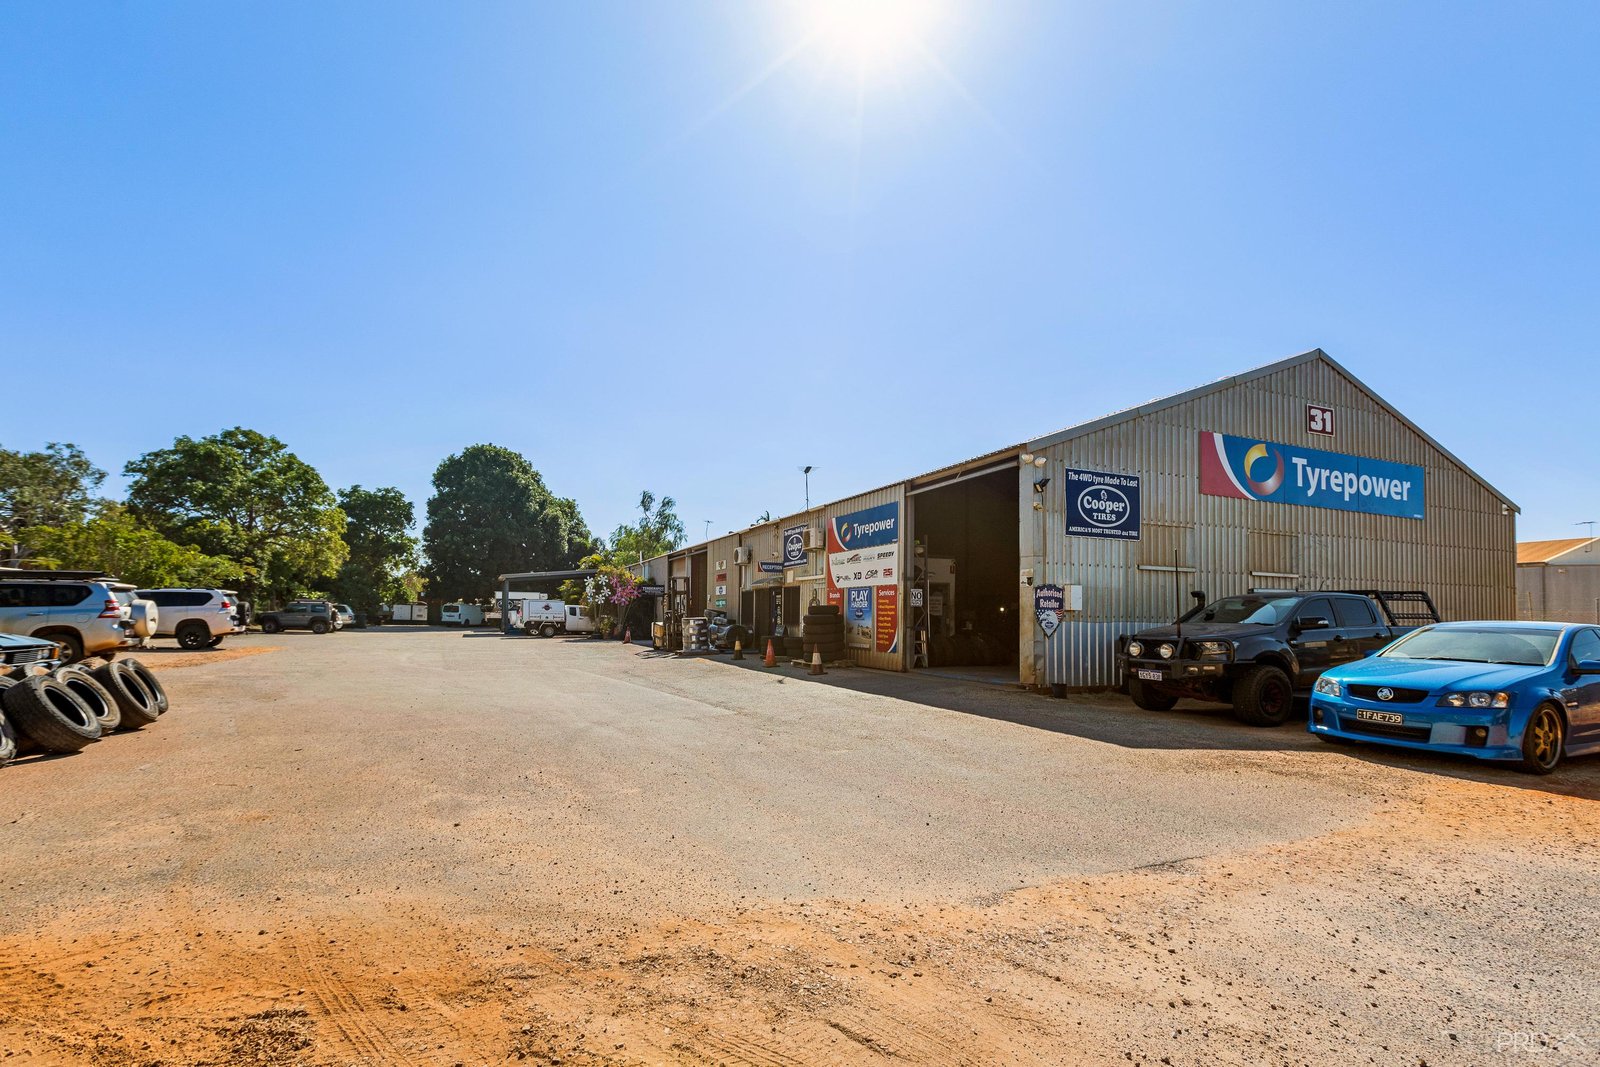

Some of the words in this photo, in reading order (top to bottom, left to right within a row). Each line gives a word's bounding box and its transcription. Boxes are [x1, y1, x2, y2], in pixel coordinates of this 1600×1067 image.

[1310, 408, 1332, 432] 31
[1068, 471, 1079, 481] The
[1079, 473, 1093, 482] 4WD
[1093, 475, 1104, 484] tyre
[1104, 476, 1120, 485] Made
[1120, 477, 1127, 486] To
[1127, 479, 1138, 487] Last
[1292, 456, 1411, 501] Tyrepower
[1083, 495, 1125, 513] Cooper
[1093, 512, 1116, 521] TIRES
[853, 518, 895, 538] Tyrepower
[877, 551, 895, 559] SPEEDY
[853, 572, 862, 580] XD
[851, 590, 868, 601] PLAY
[911, 591, 922, 600] NO
[1036, 587, 1062, 599] Authorised
[851, 600, 868, 608] HARDER
[1039, 598, 1060, 608] Retailer
[1362, 711, 1401, 723] 1FAE739
